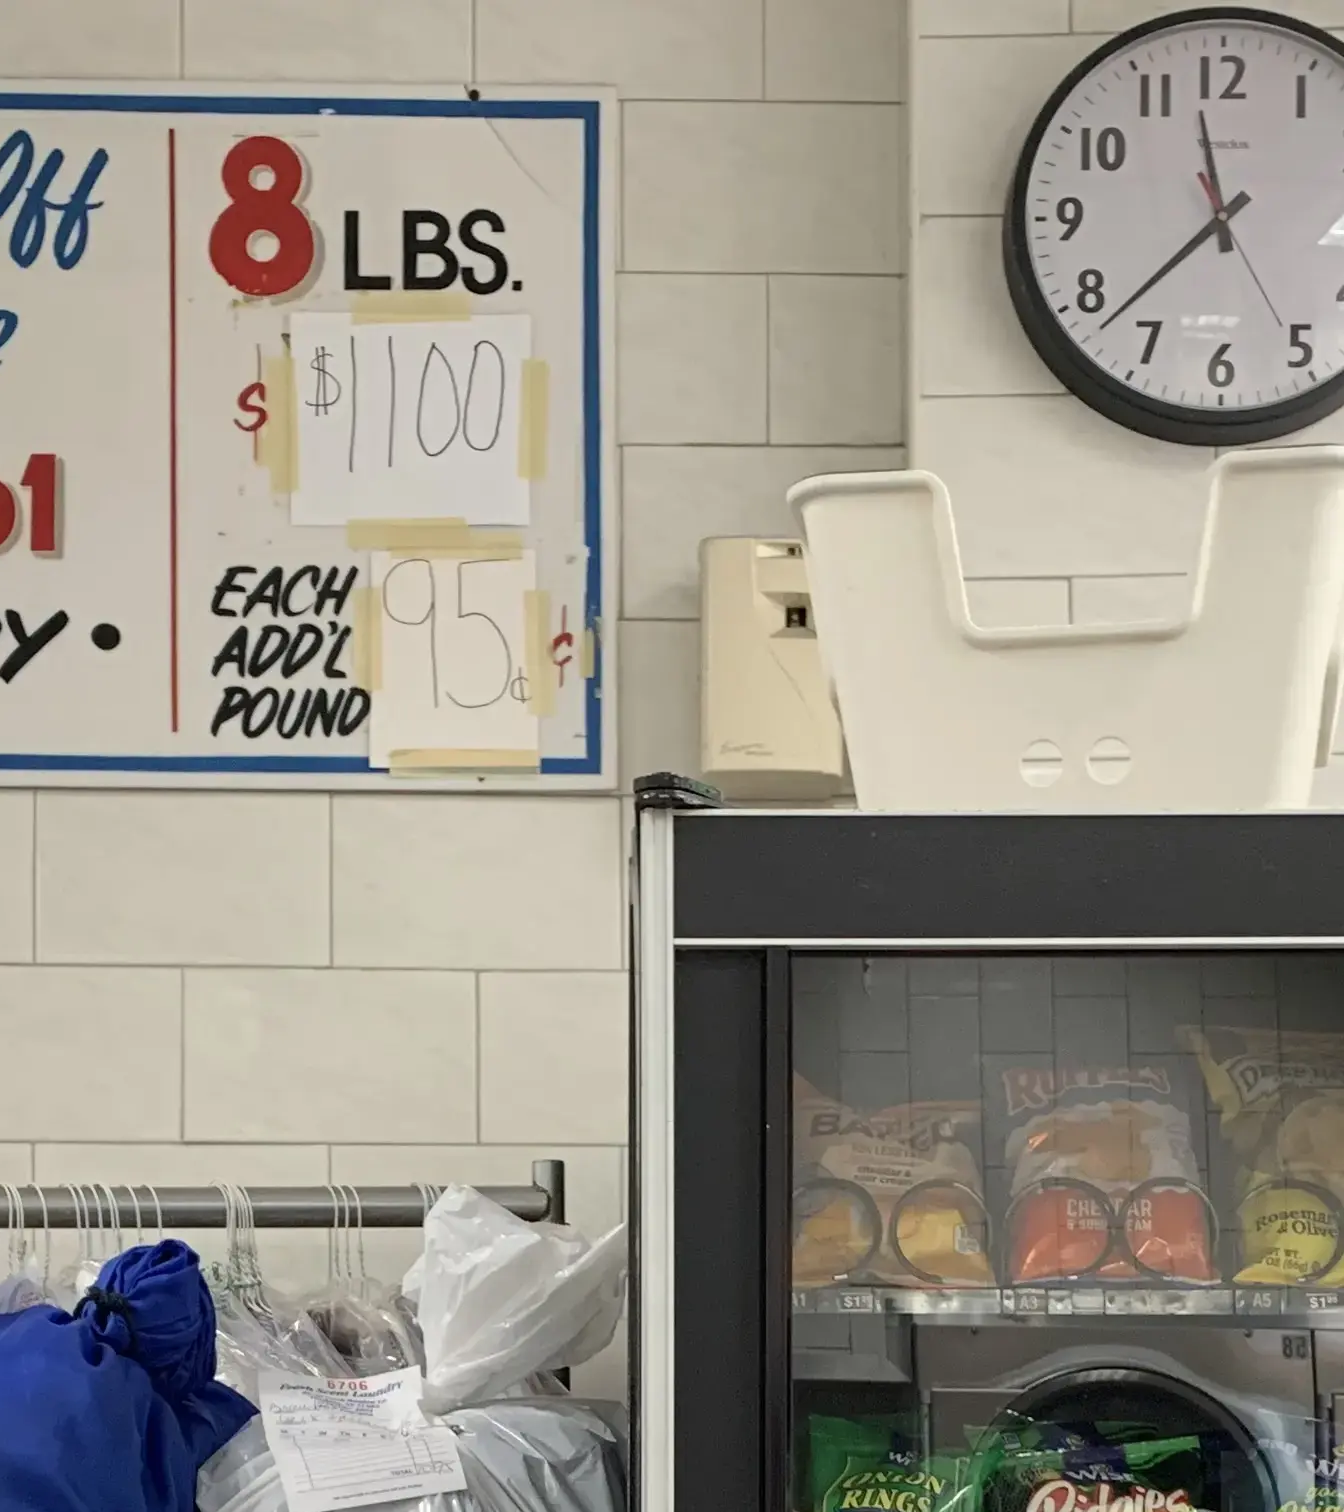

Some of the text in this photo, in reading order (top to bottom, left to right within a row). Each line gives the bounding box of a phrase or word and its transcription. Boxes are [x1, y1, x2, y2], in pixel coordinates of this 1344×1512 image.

[1139, 74, 1171, 117] 11
[1199, 55, 1247, 100] 12
[1295, 75, 1307, 118] 1
[1080, 127, 1126, 171] 10
[208, 135, 523, 300] 8 LBS.
[1056, 197, 1084, 241] 9
[1076, 269, 1105, 314] 8
[1136, 320, 1163, 365] 7
[1206, 343, 1235, 387] 6
[1287, 323, 1314, 368] 5
[212, 564, 359, 616] EACH
[212, 622, 354, 679] ADD'L
[212, 687, 371, 739] POUND
[1252, 1293, 1272, 1309] A5
[327, 1380, 368, 1391] 6706
